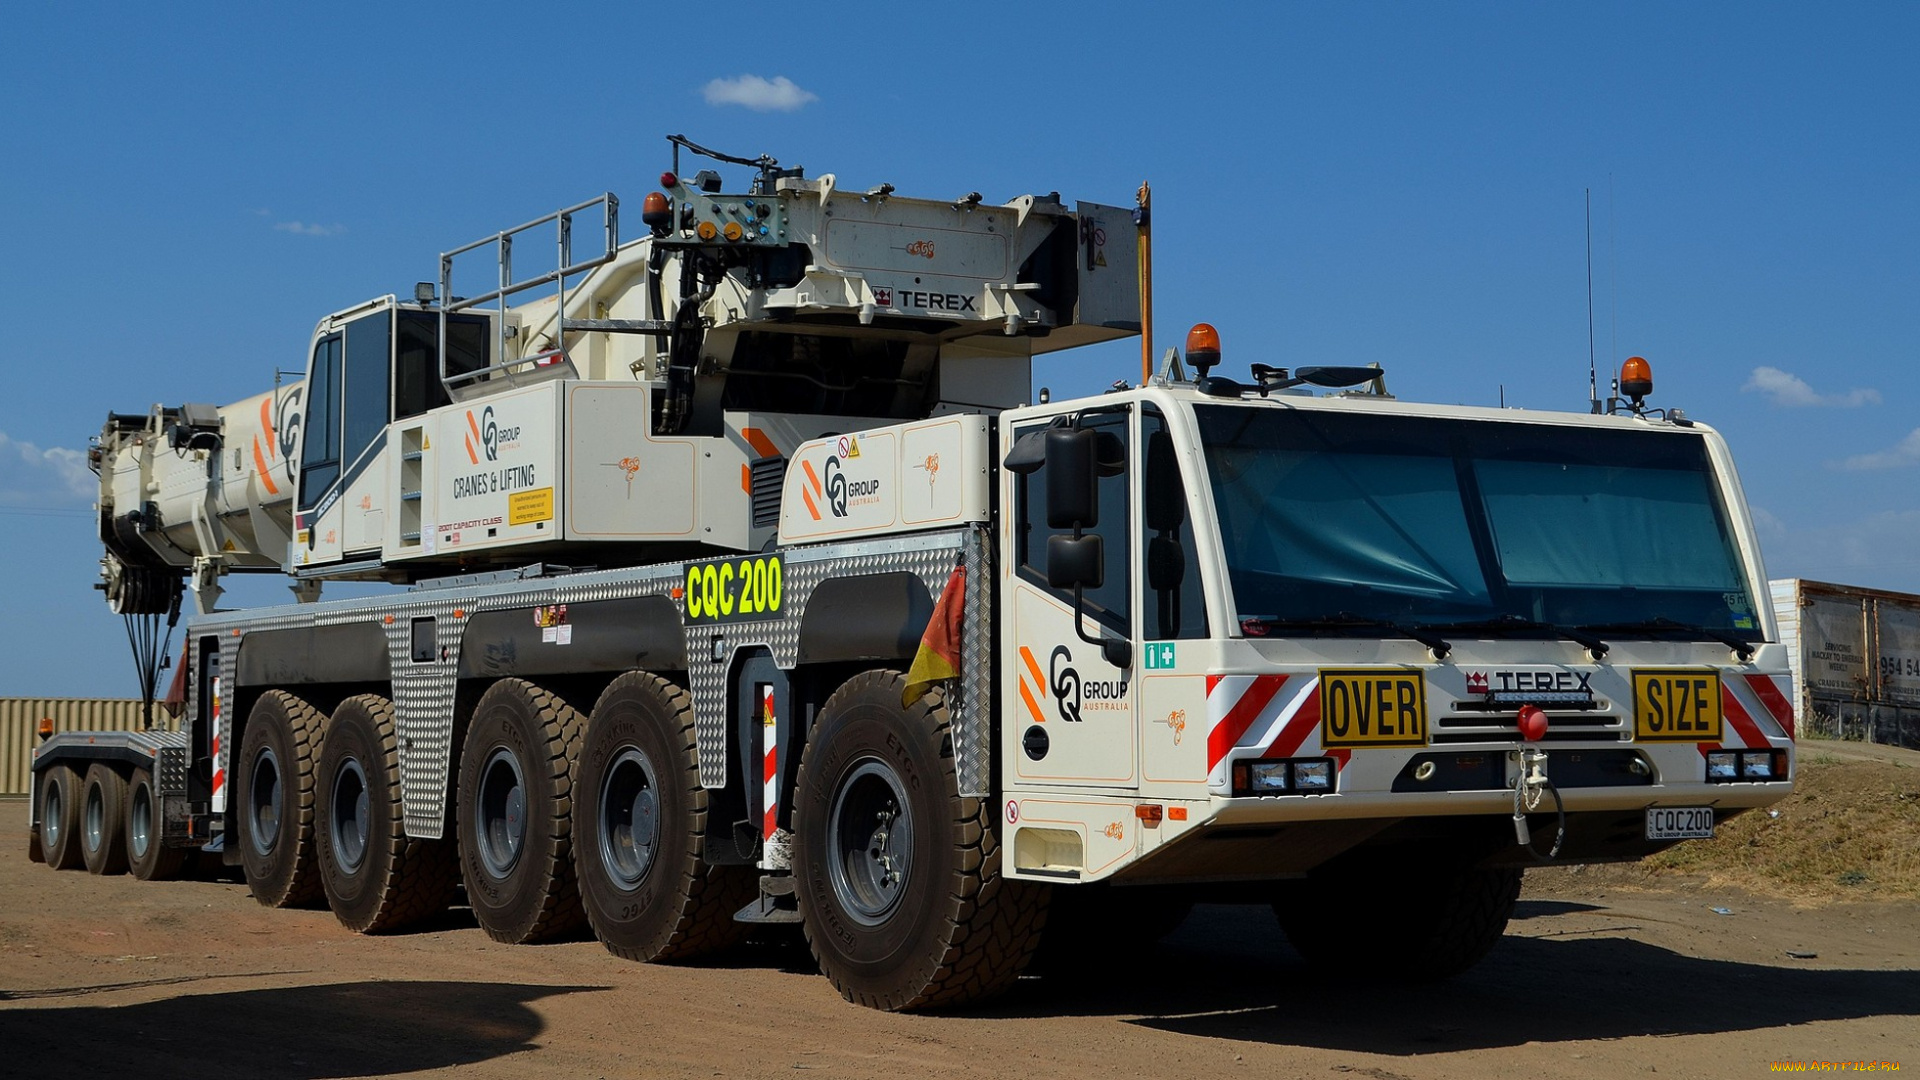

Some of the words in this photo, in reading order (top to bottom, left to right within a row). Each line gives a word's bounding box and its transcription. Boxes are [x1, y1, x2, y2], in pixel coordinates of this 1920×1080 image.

[898, 290, 975, 312] TEREX
[498, 426, 520, 443] GROUP
[453, 473, 488, 499] CRANES
[491, 472, 498, 493] &
[500, 464, 535, 491] LIFTING
[848, 479, 880, 498] GROUP
[848, 496, 880, 507] AUSTRALIA
[453, 519, 481, 531] CAPACITY
[482, 516, 502, 526] CLASS
[687, 562, 734, 620] CQC
[739, 557, 781, 614] 200
[1829, 662, 1848, 671] WEEKLY
[1833, 653, 1840, 662] TO
[1874, 656, 1902, 675] 954
[1083, 681, 1128, 699] GROUP
[1495, 672, 1593, 692] TEREX
[1083, 702, 1129, 711] AUSTRALIA
[1330, 679, 1419, 737] OVER
[1647, 678, 1709, 732] SIZE
[885, 731, 920, 791] ETGC
[1656, 810, 1711, 831] CQC200
